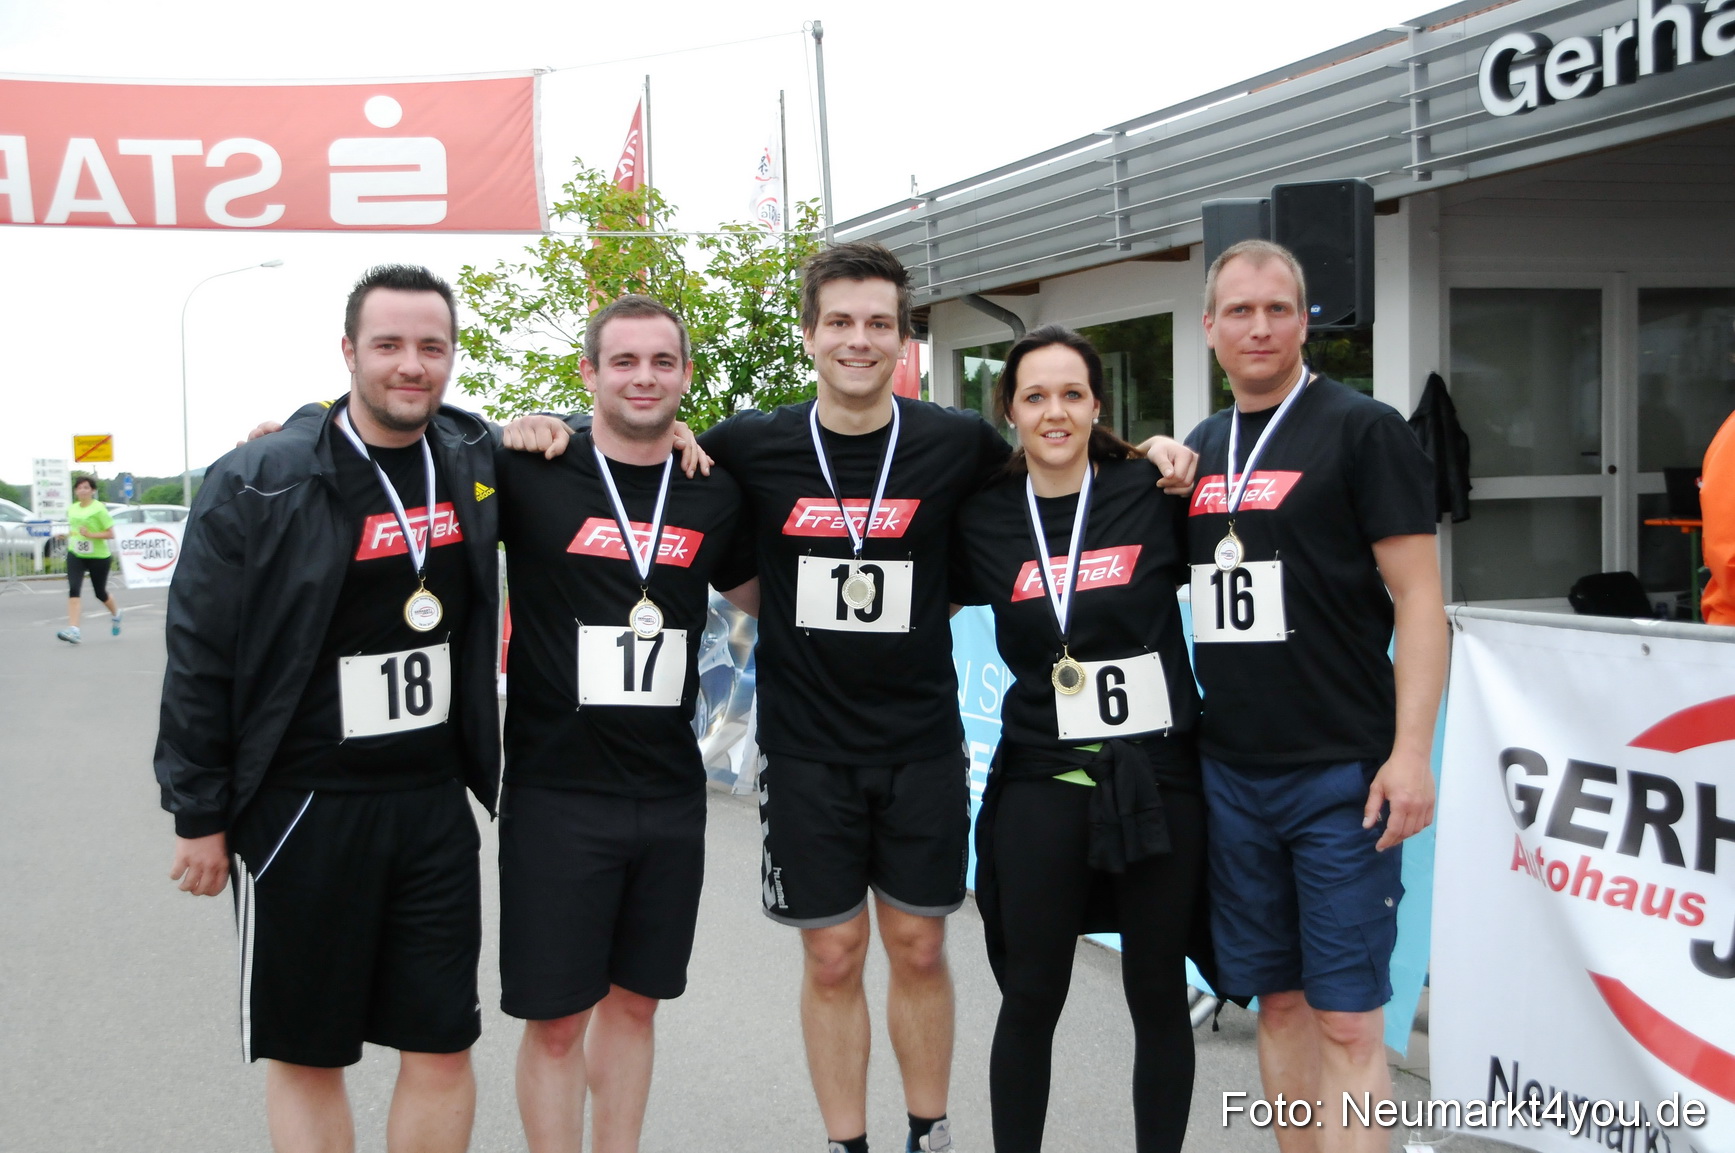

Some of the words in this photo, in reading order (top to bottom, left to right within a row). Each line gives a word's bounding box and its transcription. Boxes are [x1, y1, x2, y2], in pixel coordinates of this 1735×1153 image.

[78, 540, 90, 551] 38
[121, 538, 167, 550] GERHART
[795, 506, 901, 531] Franek
[831, 564, 885, 623] 10
[1210, 567, 1255, 631] 16
[381, 651, 434, 720] 18
[616, 631, 665, 692] 17
[1095, 664, 1129, 726] 6
